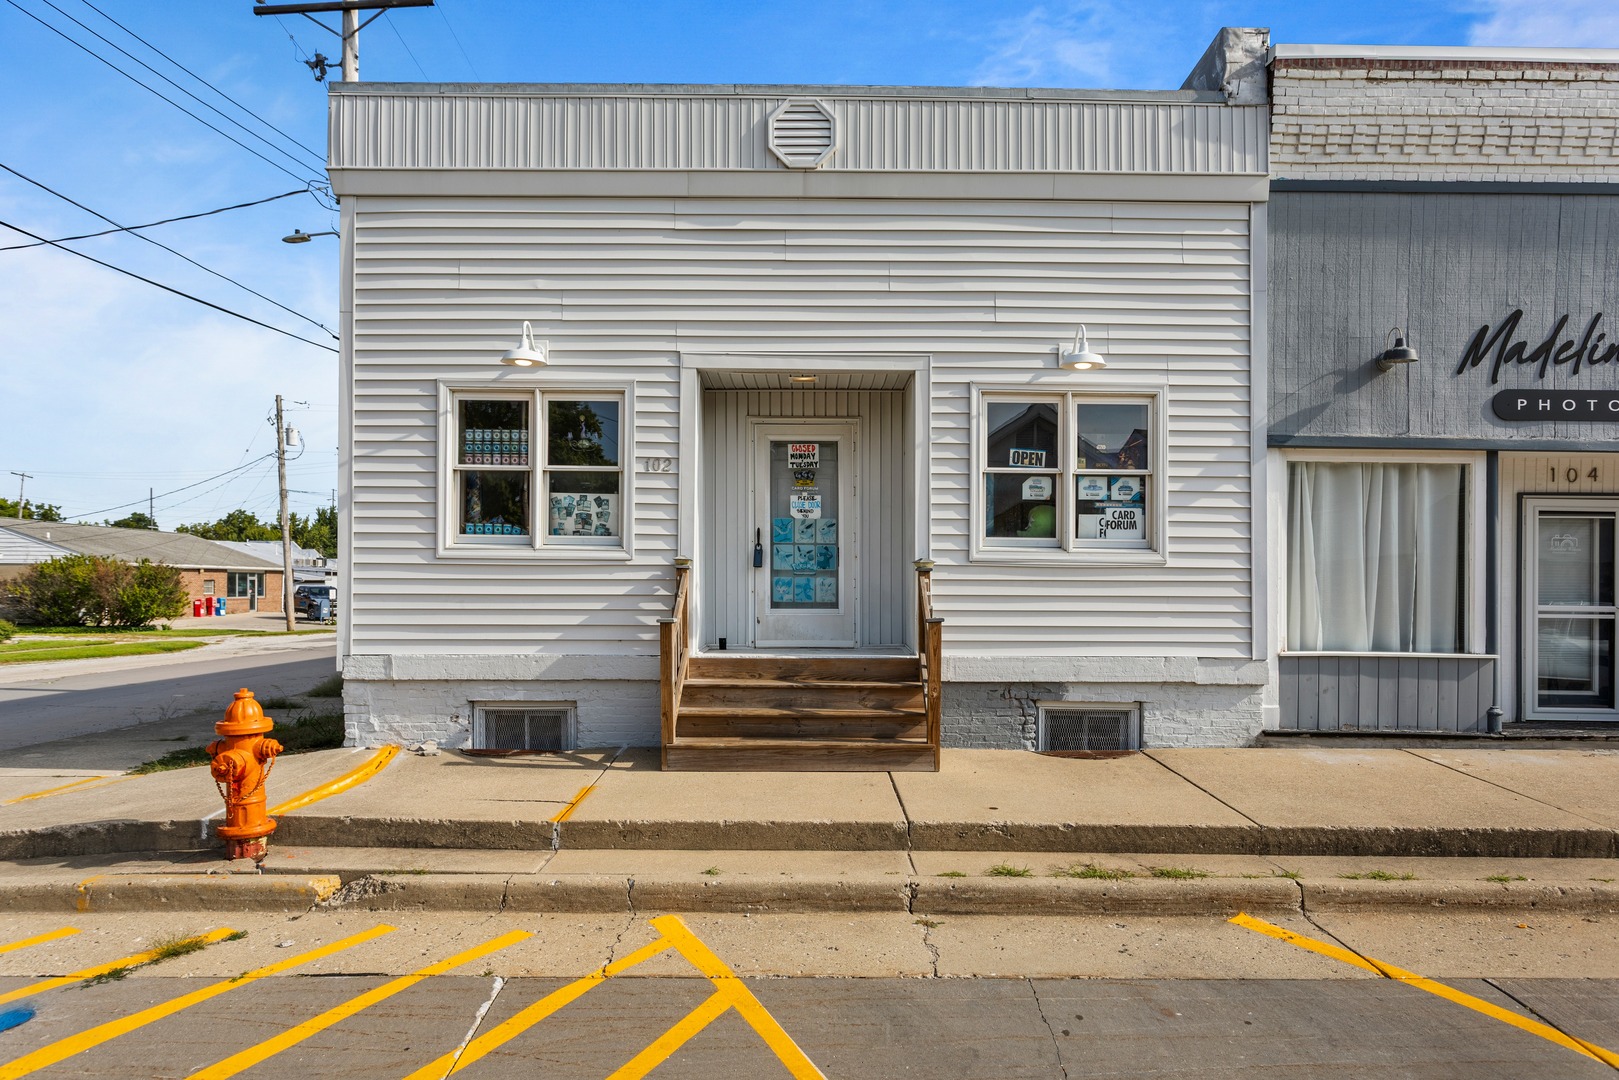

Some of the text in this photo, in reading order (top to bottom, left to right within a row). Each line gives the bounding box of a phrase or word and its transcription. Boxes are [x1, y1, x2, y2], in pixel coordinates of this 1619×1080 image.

[644, 457, 672, 472] 102
[1011, 450, 1044, 466] OPEN
[1550, 467, 1598, 482] 104
[1111, 510, 1136, 520] CARD
[1106, 520, 1138, 530] FORUM
